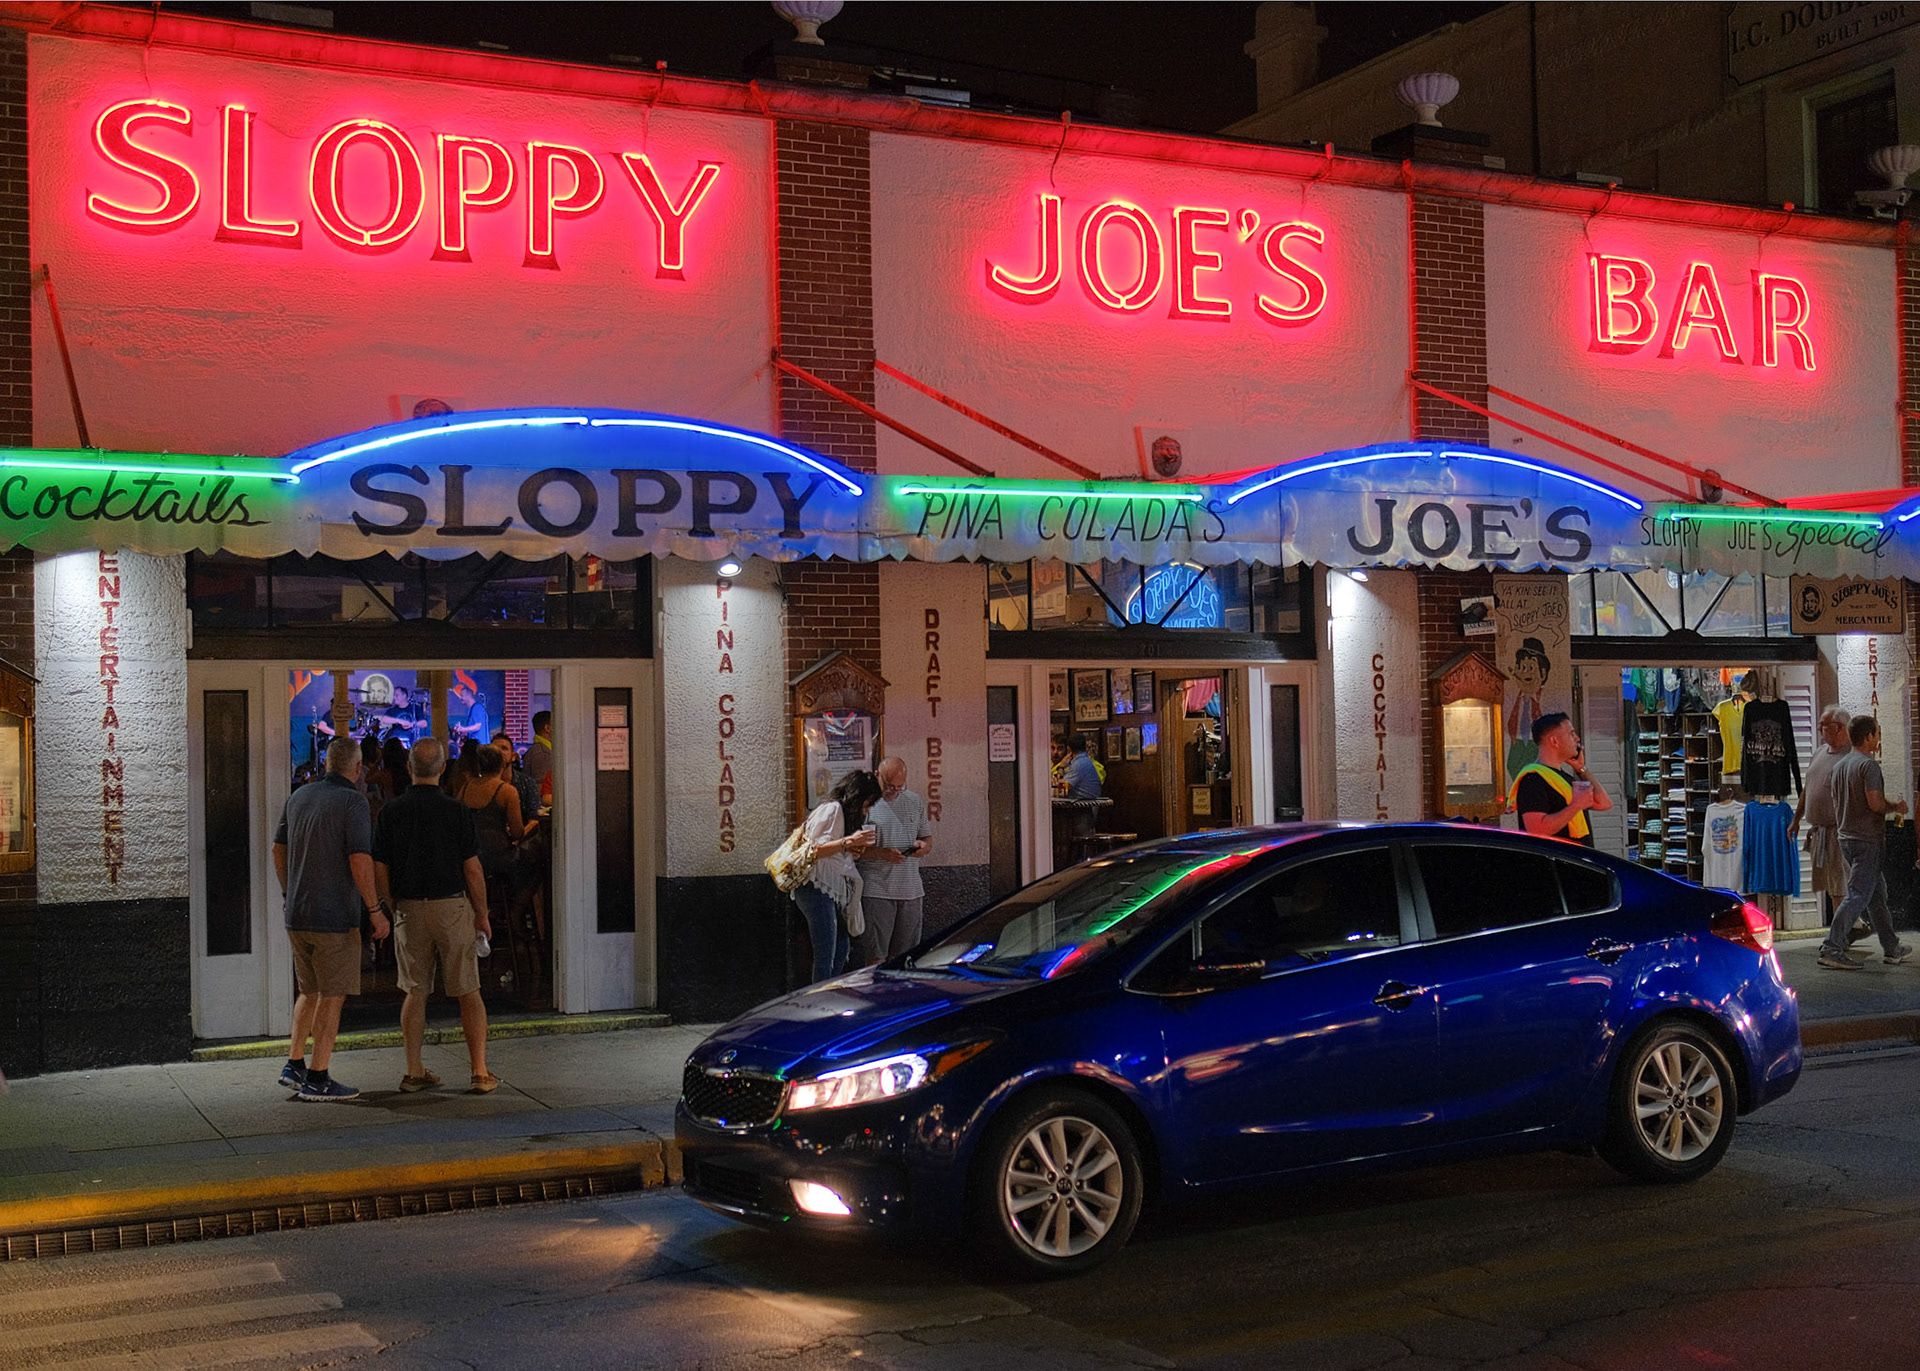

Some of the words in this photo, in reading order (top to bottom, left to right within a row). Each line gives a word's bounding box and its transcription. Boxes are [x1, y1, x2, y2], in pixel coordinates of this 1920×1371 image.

[86, 99, 724, 281] SLOPPY
[985, 194, 1328, 328] JOE'S
[1586, 252, 1816, 371] BAR
[1, 470, 271, 527] Cocktails
[349, 464, 824, 539] SLOPPY
[1347, 498, 1593, 562] JOE'S
[916, 484, 1004, 540] PIÑA
[1641, 517, 1702, 548] SLOPPY
[1728, 520, 1772, 550] JOE'S
[1775, 520, 1896, 564] Special
[1516, 600, 1527, 609] AT
[1533, 586, 1546, 597] SEE
[1831, 583, 1872, 608] SLOPPY
[1836, 616, 1894, 625] MERCANTILE
[925, 608, 942, 718] DRAFT
[98, 549, 125, 886] ENTERTAINMENT
[718, 694, 736, 853] COLADAS
[926, 738, 943, 822] BEER
